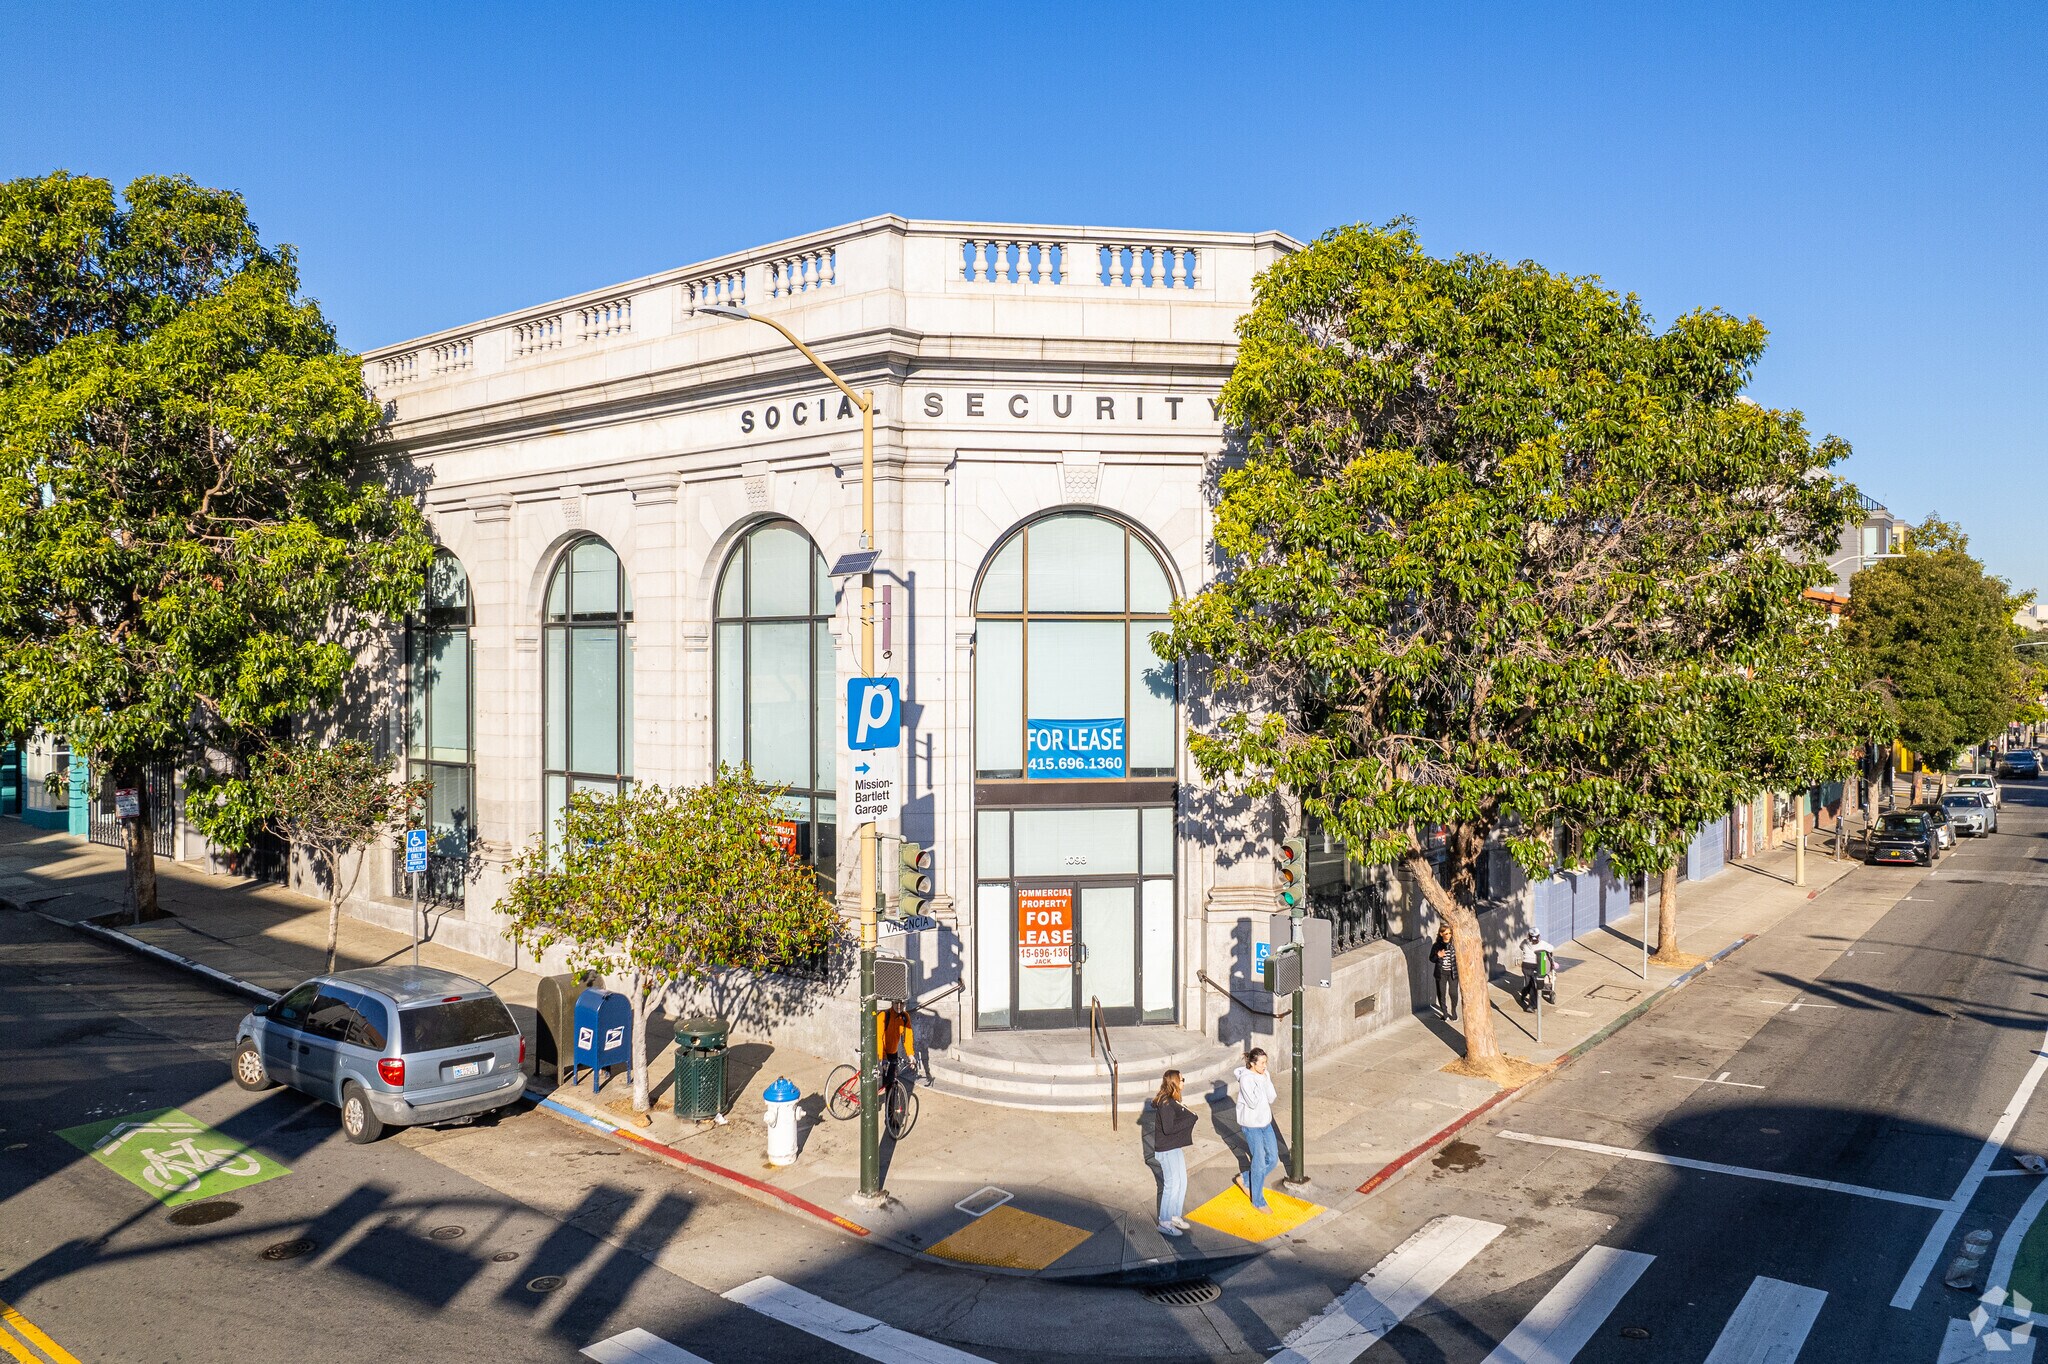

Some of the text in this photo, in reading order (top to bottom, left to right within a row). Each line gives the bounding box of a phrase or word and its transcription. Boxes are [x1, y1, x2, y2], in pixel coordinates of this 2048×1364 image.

[741, 396, 880, 434] SOCIA
[1027, 728, 1123, 751] FOR LEASE
[1027, 756, 1123, 770] 415.696.1360
[855, 779, 894, 790] Mission-
[855, 790, 890, 803] Bartlett
[855, 804, 888, 816] Garage
[1022, 899, 1067, 908] PROPERTY
[1026, 911, 1062, 925] FOR
[886, 917, 929, 933] VALENCIA
[1019, 947, 1072, 958] 15-696-136
